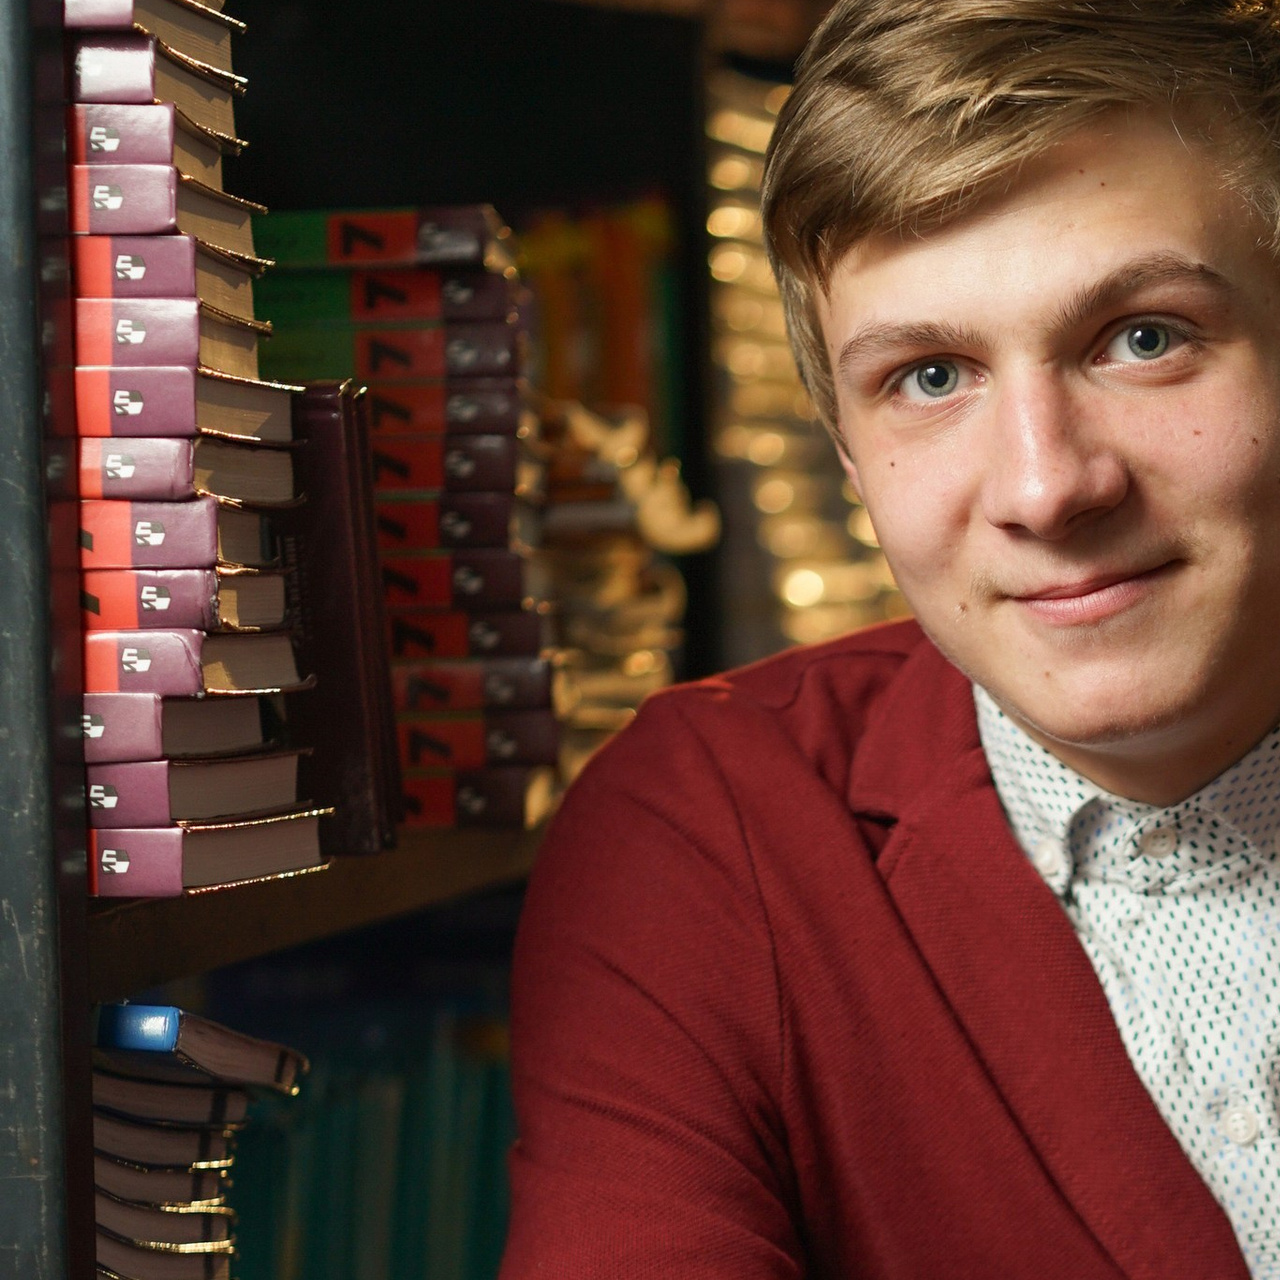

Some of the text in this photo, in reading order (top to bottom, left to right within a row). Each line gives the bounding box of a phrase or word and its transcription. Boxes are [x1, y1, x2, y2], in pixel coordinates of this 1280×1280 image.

[342, 221, 386, 256] 7
[363, 277, 409, 311] 7
[369, 337, 412, 373] 7
[371, 393, 412, 429] 7
[392, 617, 434, 656] 7
[409, 677, 450, 708] 7
[411, 729, 452, 765] 7
